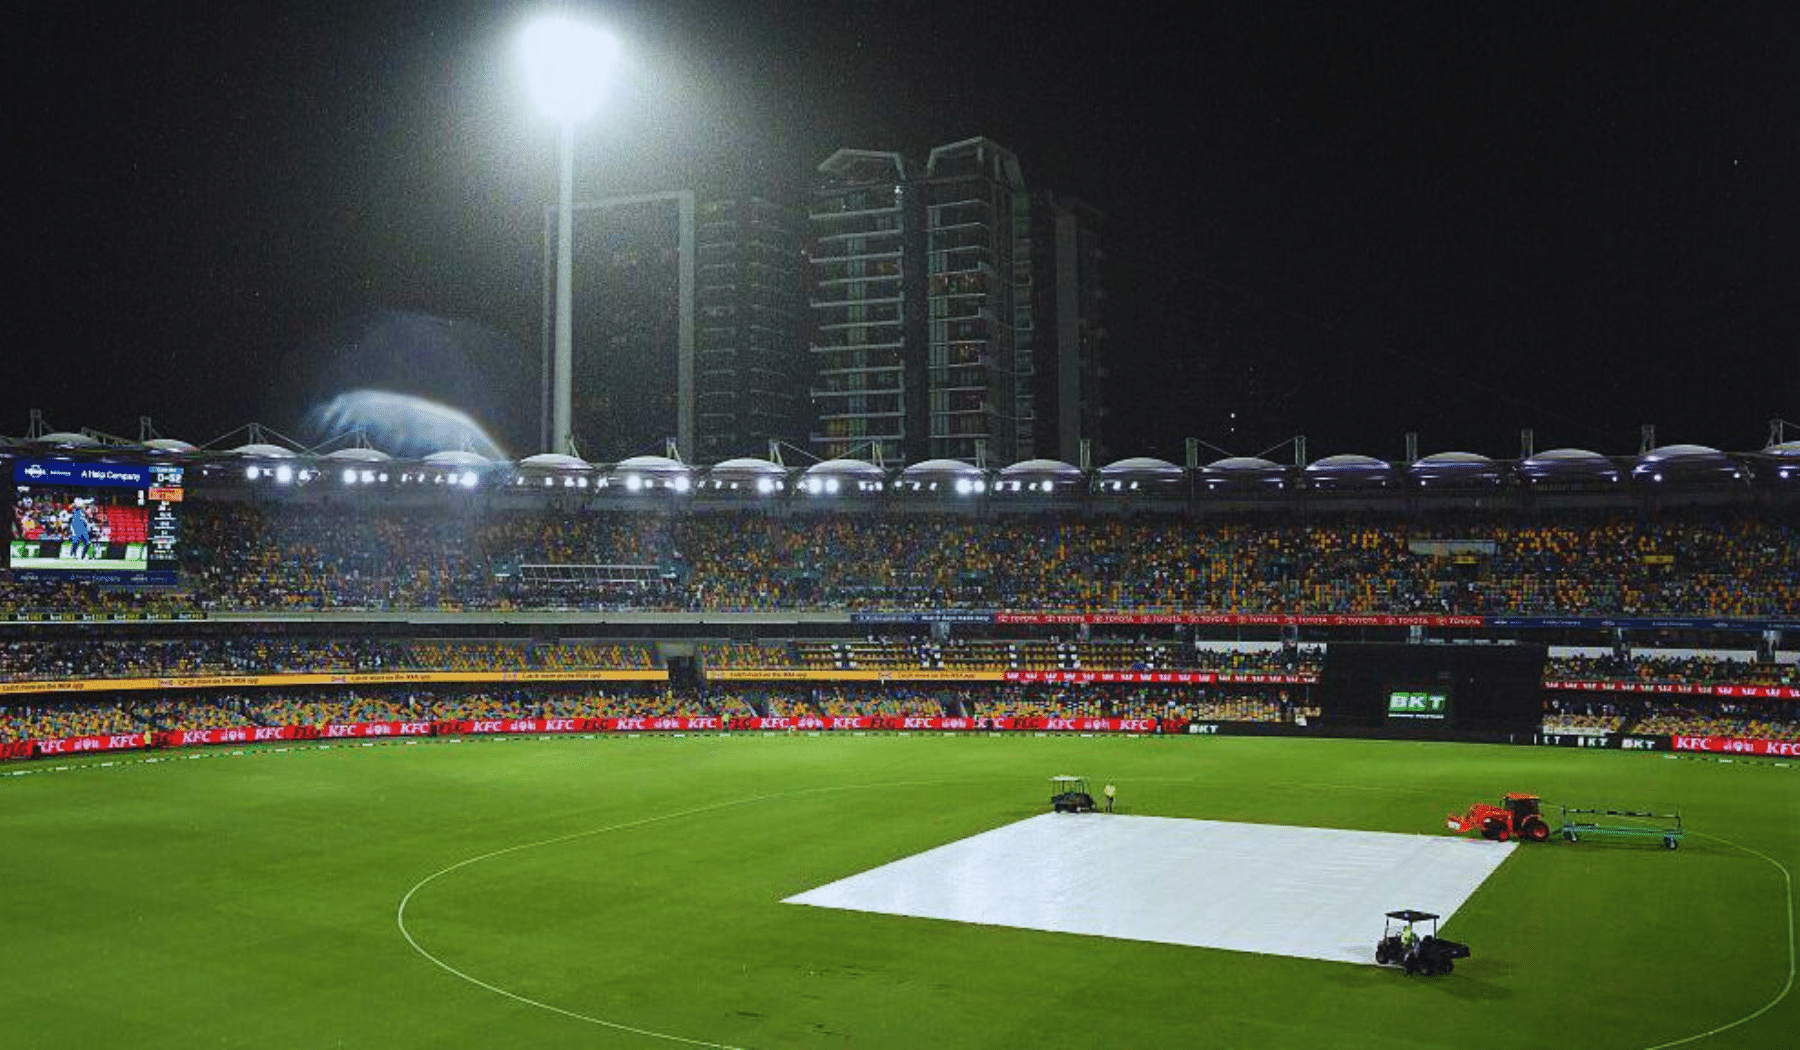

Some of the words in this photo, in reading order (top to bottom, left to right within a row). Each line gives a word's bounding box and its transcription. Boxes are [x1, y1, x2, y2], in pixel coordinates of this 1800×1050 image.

[81, 470, 88, 478] A
[106, 471, 140, 482] Company
[1390, 696, 1446, 710] BKT
[400, 722, 429, 734] KFC
[474, 721, 502, 732] KFC
[546, 720, 574, 730] KFC
[617, 718, 646, 730] KFC
[688, 718, 716, 729] KFC
[760, 718, 790, 728] KFC
[834, 718, 860, 728] KFC
[904, 718, 930, 728] KFC
[978, 718, 1004, 728] KC
[1047, 719, 1074, 730] KFC
[1120, 719, 1148, 730] KFC
[1189, 723, 1218, 734] BKT
[254, 726, 284, 740] KFC
[328, 724, 358, 736] KFC
[108, 734, 138, 748] KFC
[182, 730, 212, 744] KFC
[37, 739, 66, 753] KFC
[1622, 738, 1655, 749] BKT
[1676, 738, 1710, 750] KFC
[1765, 742, 1800, 755] KFC
